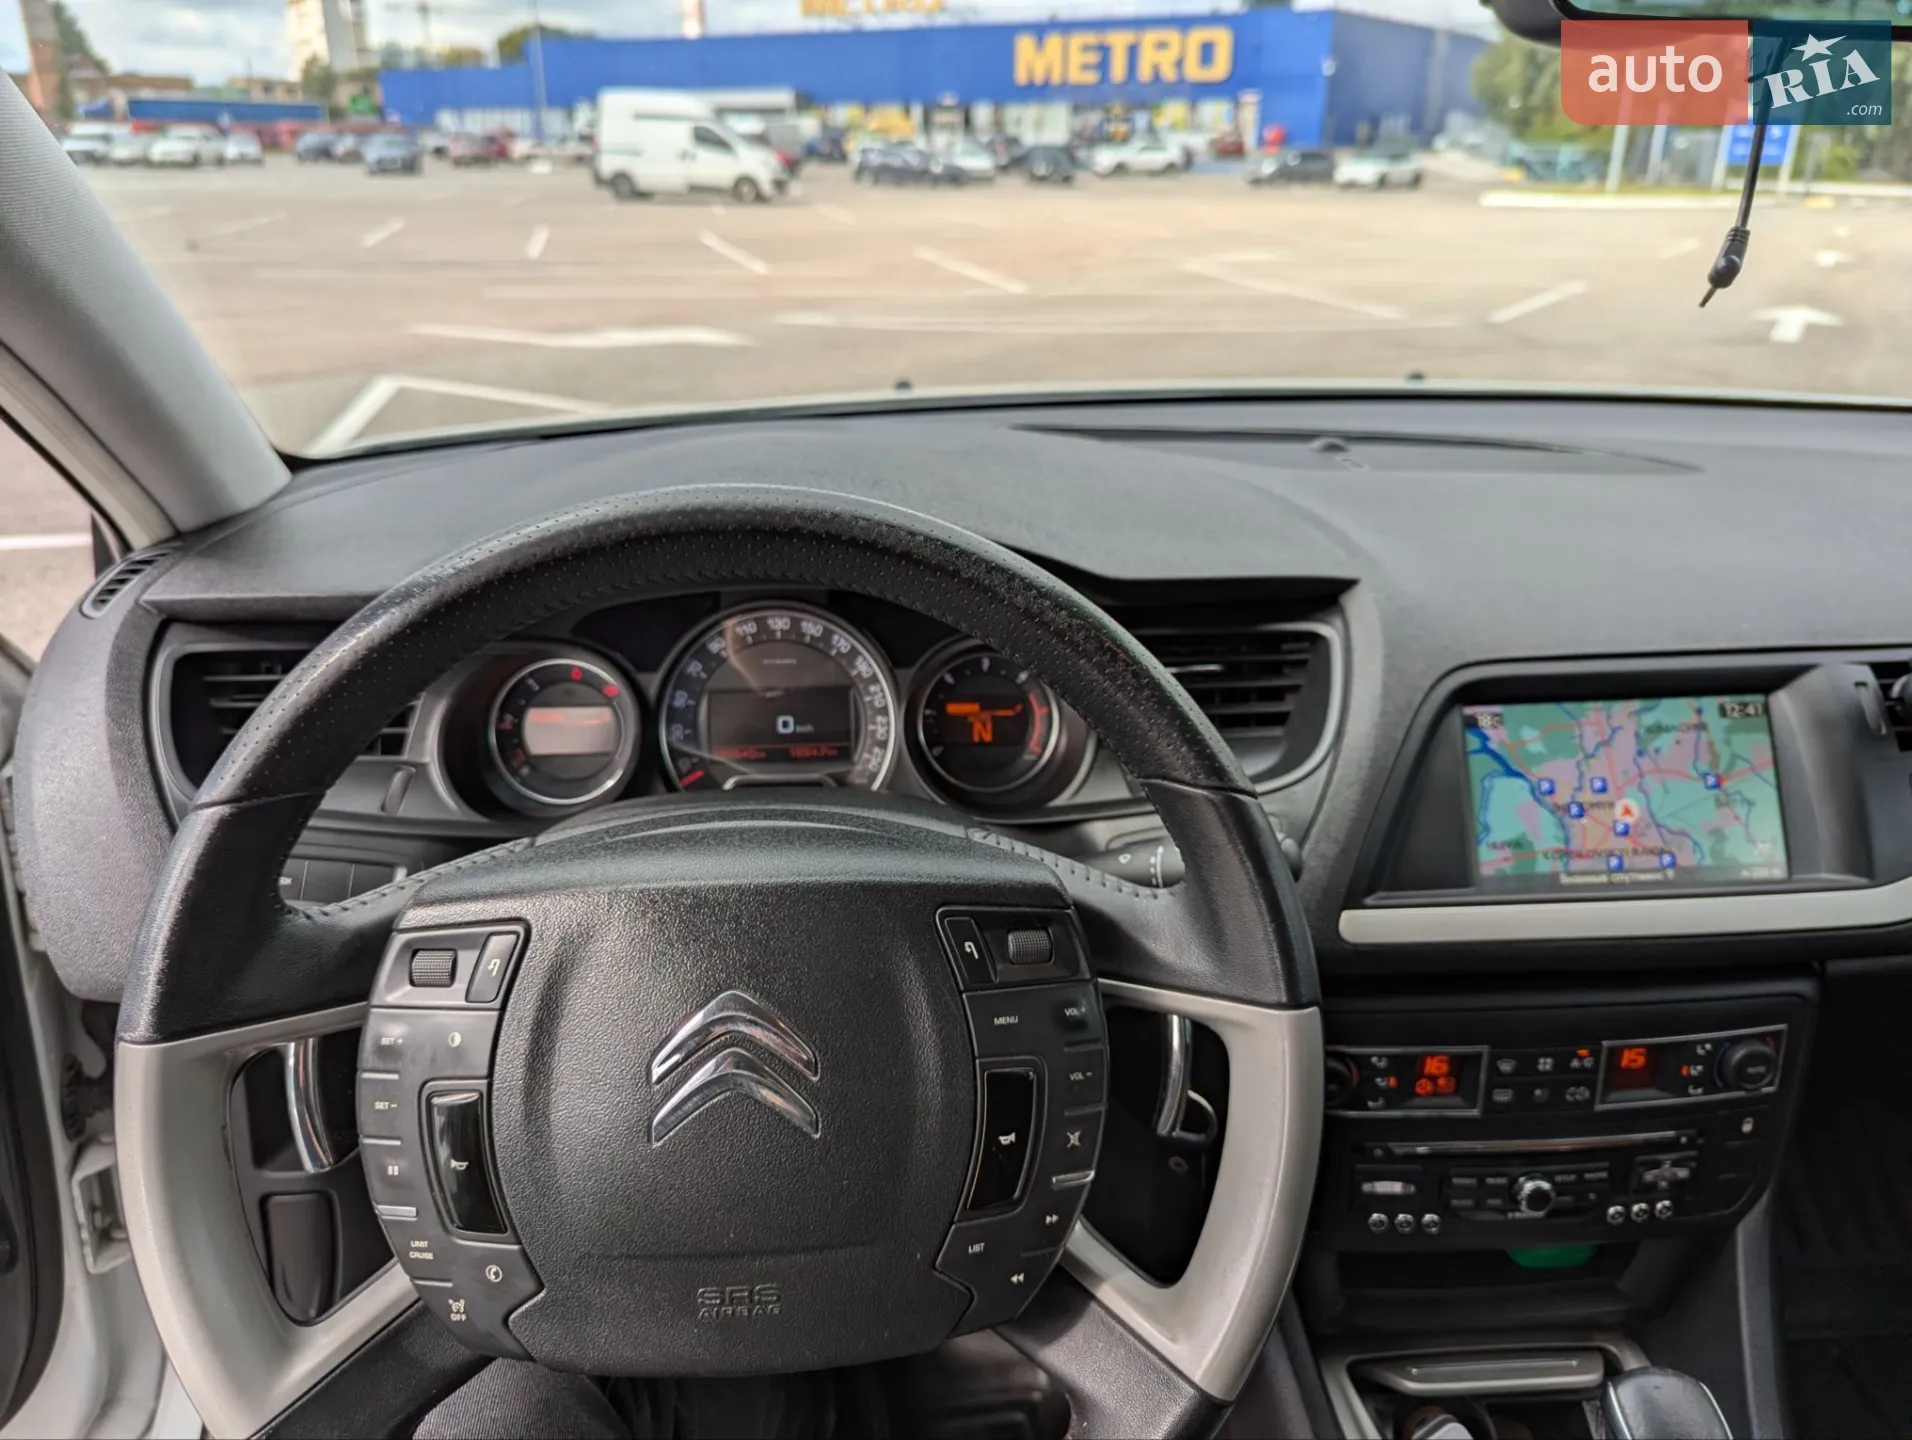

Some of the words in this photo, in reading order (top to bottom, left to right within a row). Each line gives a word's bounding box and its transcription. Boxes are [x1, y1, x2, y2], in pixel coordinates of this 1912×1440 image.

[1013, 25, 1234, 86] METRO
[735, 620, 758, 636] 110
[766, 616, 791, 631] 130
[800, 620, 823, 637] 150
[831, 633, 852, 653] 170
[1725, 702, 1765, 718] 12:41
[776, 715, 795, 735] 0
[972, 714, 993, 743] N
[1064, 1007, 1079, 1017] VOL
[993, 1015, 1019, 1026] MENU
[381, 1037, 395, 1046] SET
[1423, 1055, 1450, 1076] 16
[1620, 1048, 1648, 1069] 15
[1069, 1071, 1084, 1081] VOL
[374, 1101, 389, 1110] SET
[410, 1240, 429, 1248] LIMIT
[968, 1242, 985, 1254] LIST
[409, 1251, 435, 1260] CRUISE
[697, 1283, 781, 1305] SRS
[450, 1313, 467, 1322] OFF
[698, 1304, 781, 1319] AIRBAG
